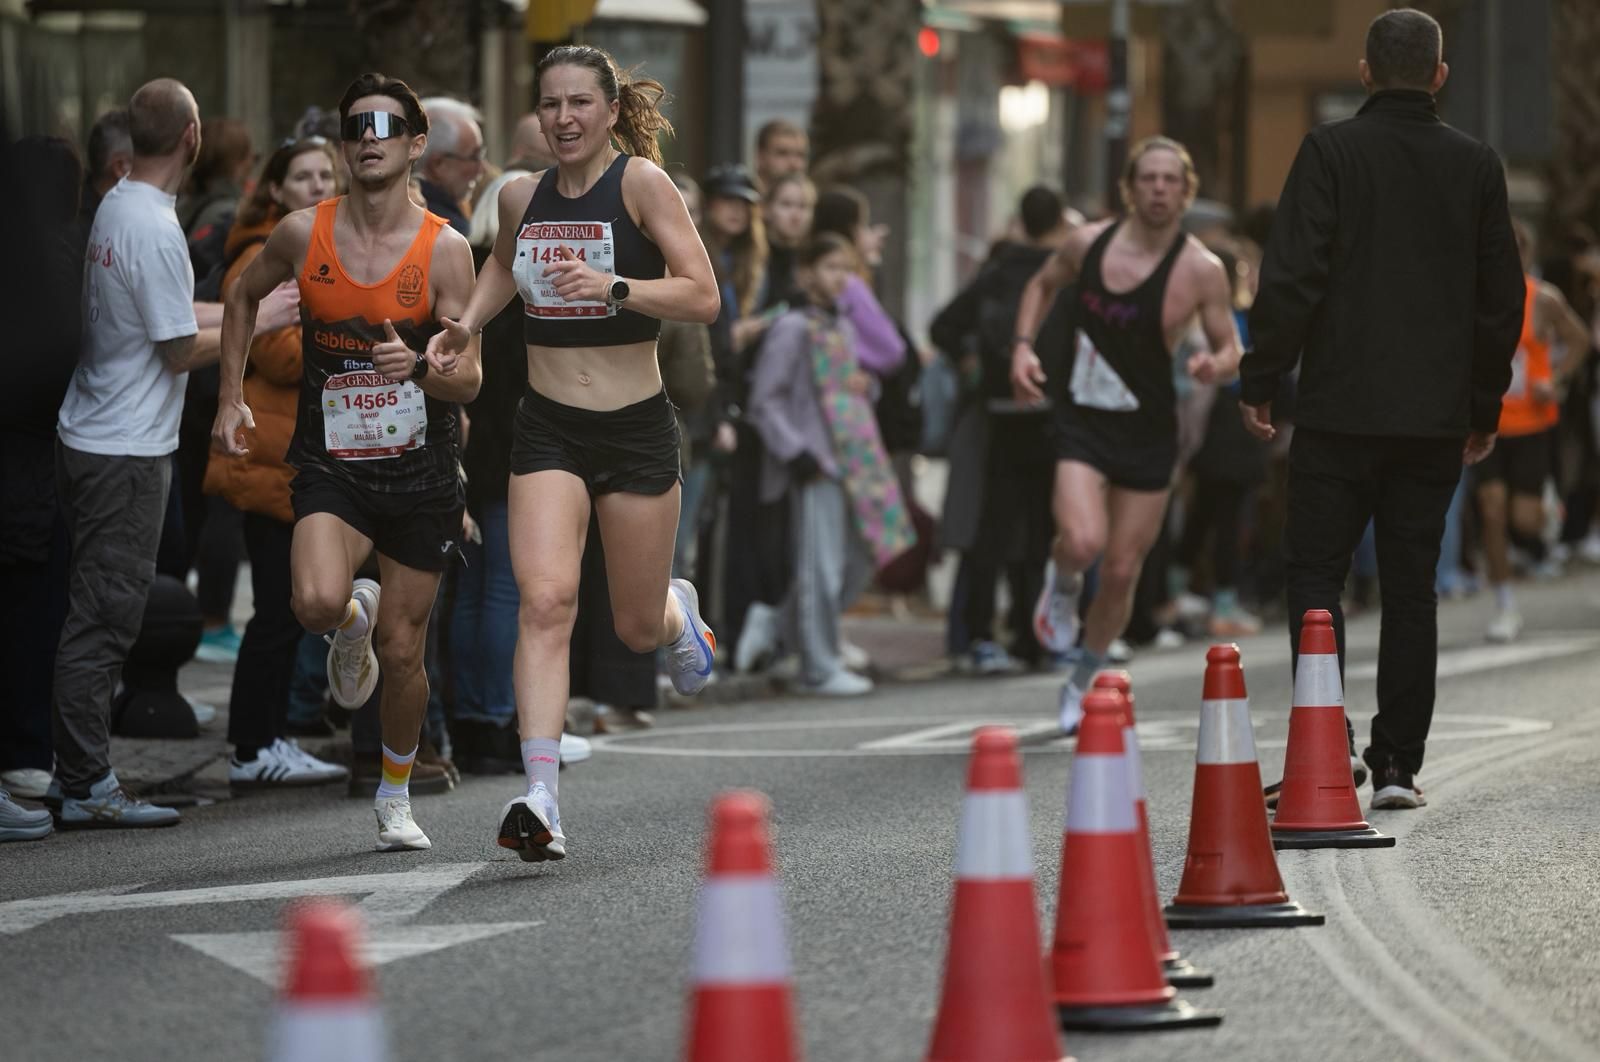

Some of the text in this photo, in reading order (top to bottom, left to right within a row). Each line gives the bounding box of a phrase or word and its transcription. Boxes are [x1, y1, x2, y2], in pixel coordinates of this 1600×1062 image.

[540, 225, 595, 239] GENERALI
[531, 246, 587, 264] 1454
[309, 274, 336, 285] VIATOR
[343, 359, 374, 370] fibra
[341, 390, 398, 410] 14565
[360, 411, 380, 419] DAVID
